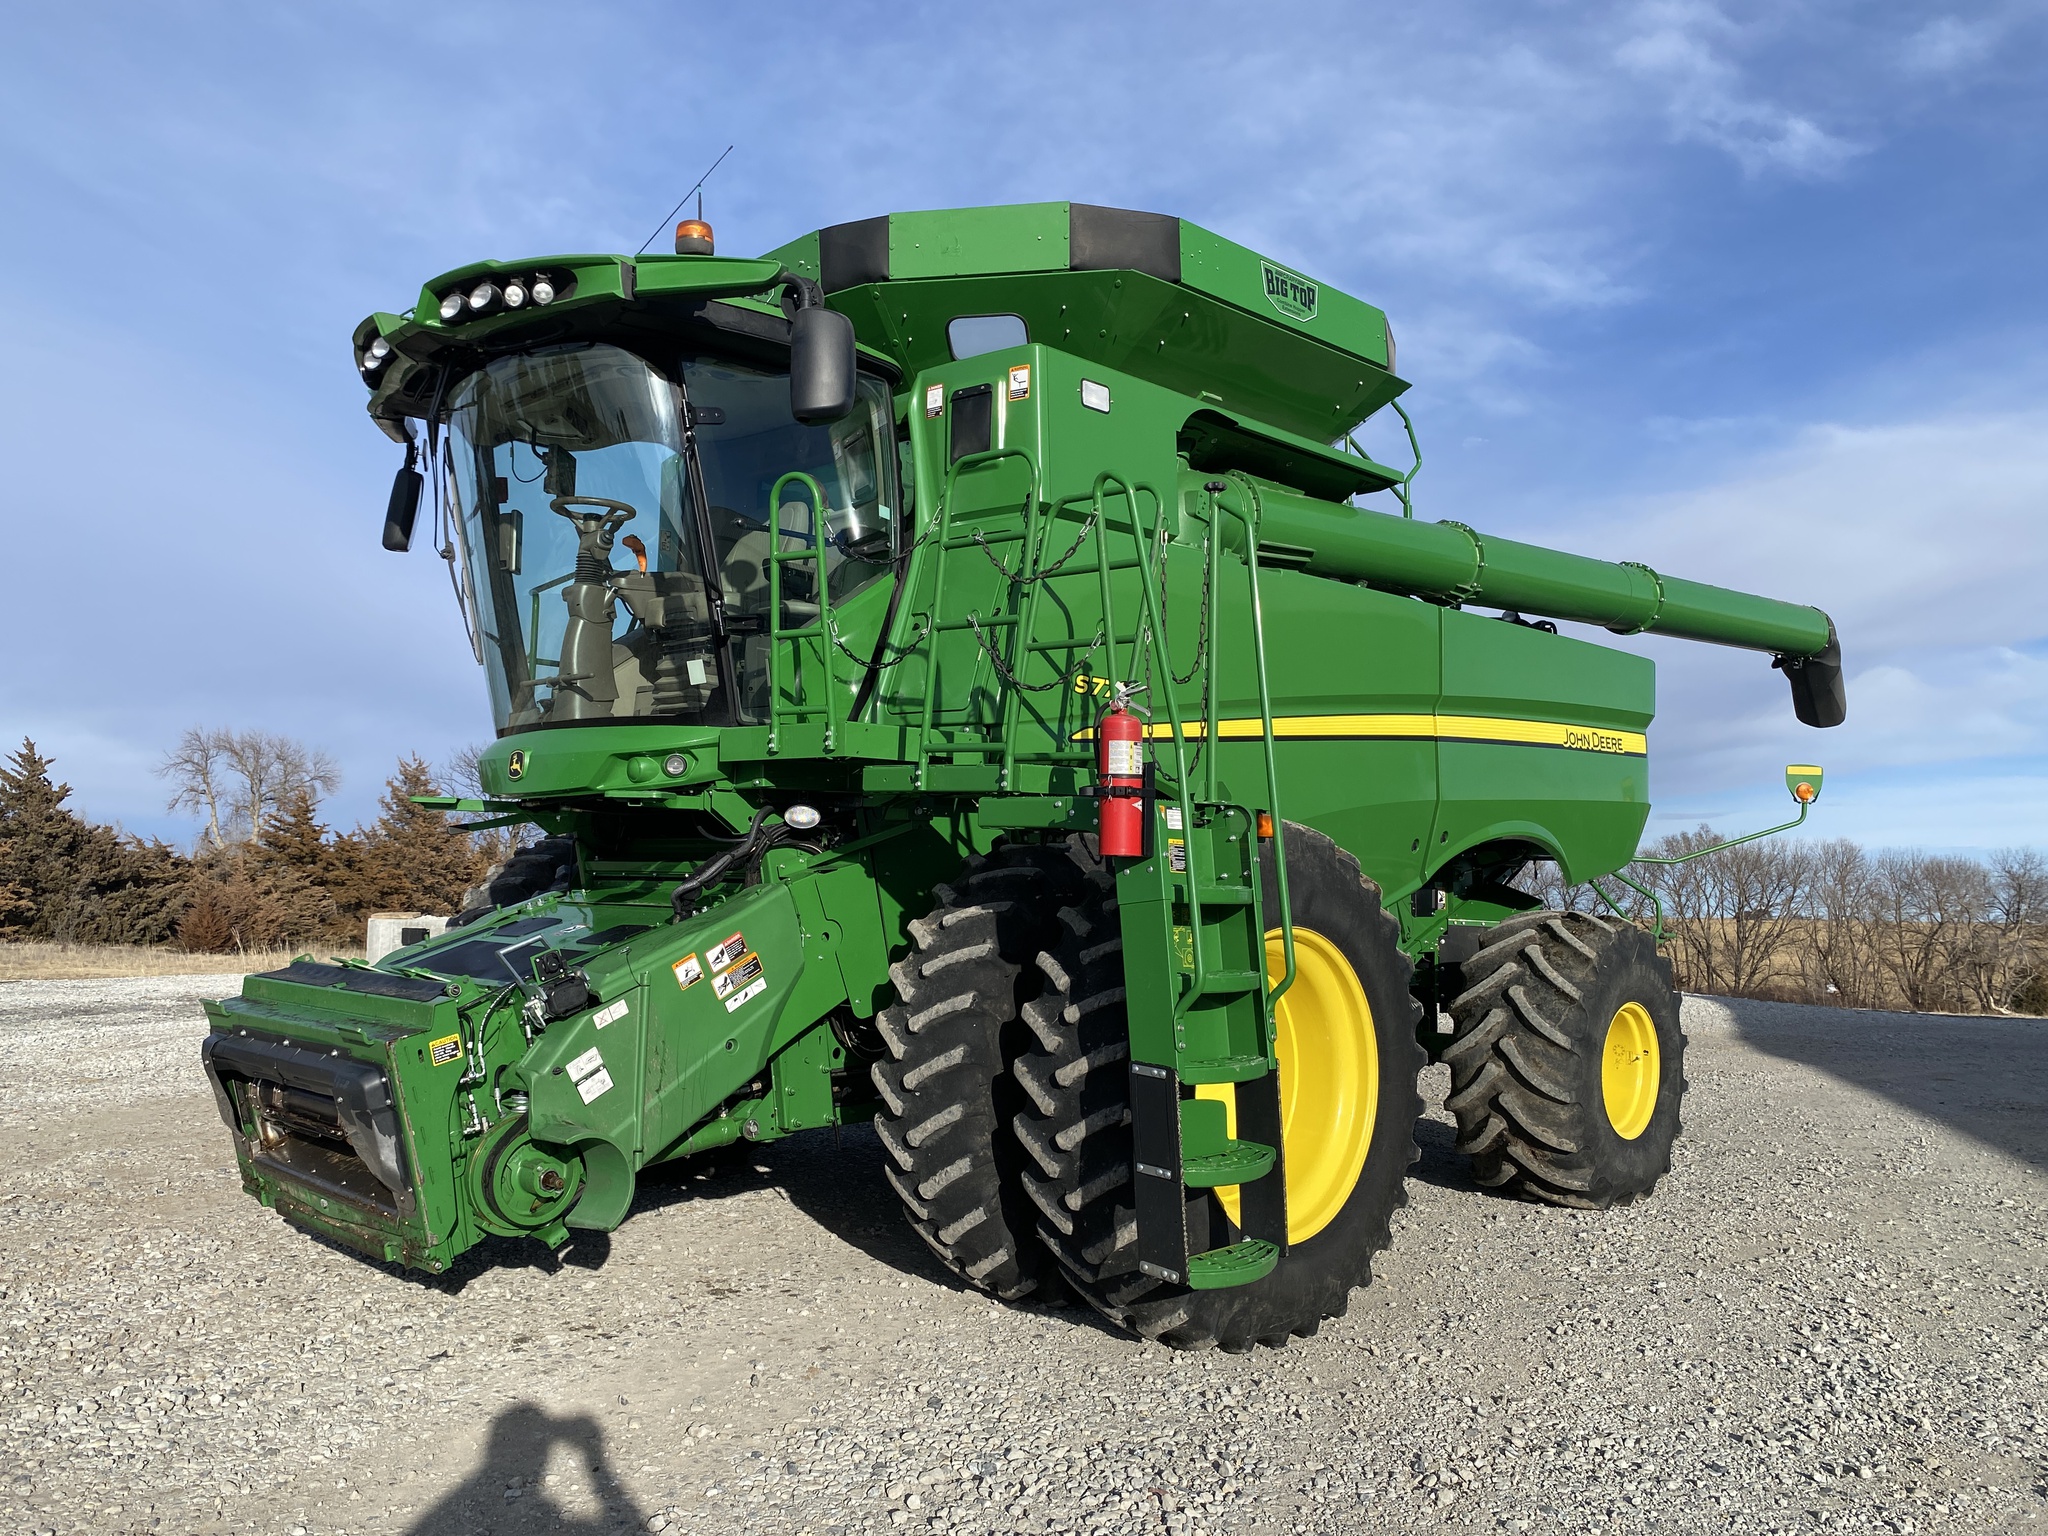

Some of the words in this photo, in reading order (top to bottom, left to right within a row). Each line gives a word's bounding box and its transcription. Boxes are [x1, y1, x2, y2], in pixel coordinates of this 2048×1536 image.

[1265, 268, 1288, 298] BIG
[1290, 282, 1315, 312] TOP
[1563, 728, 1591, 748] JOHN
[1591, 732, 1624, 751] DEERE
[434, 1035, 458, 1046] CAUTION
